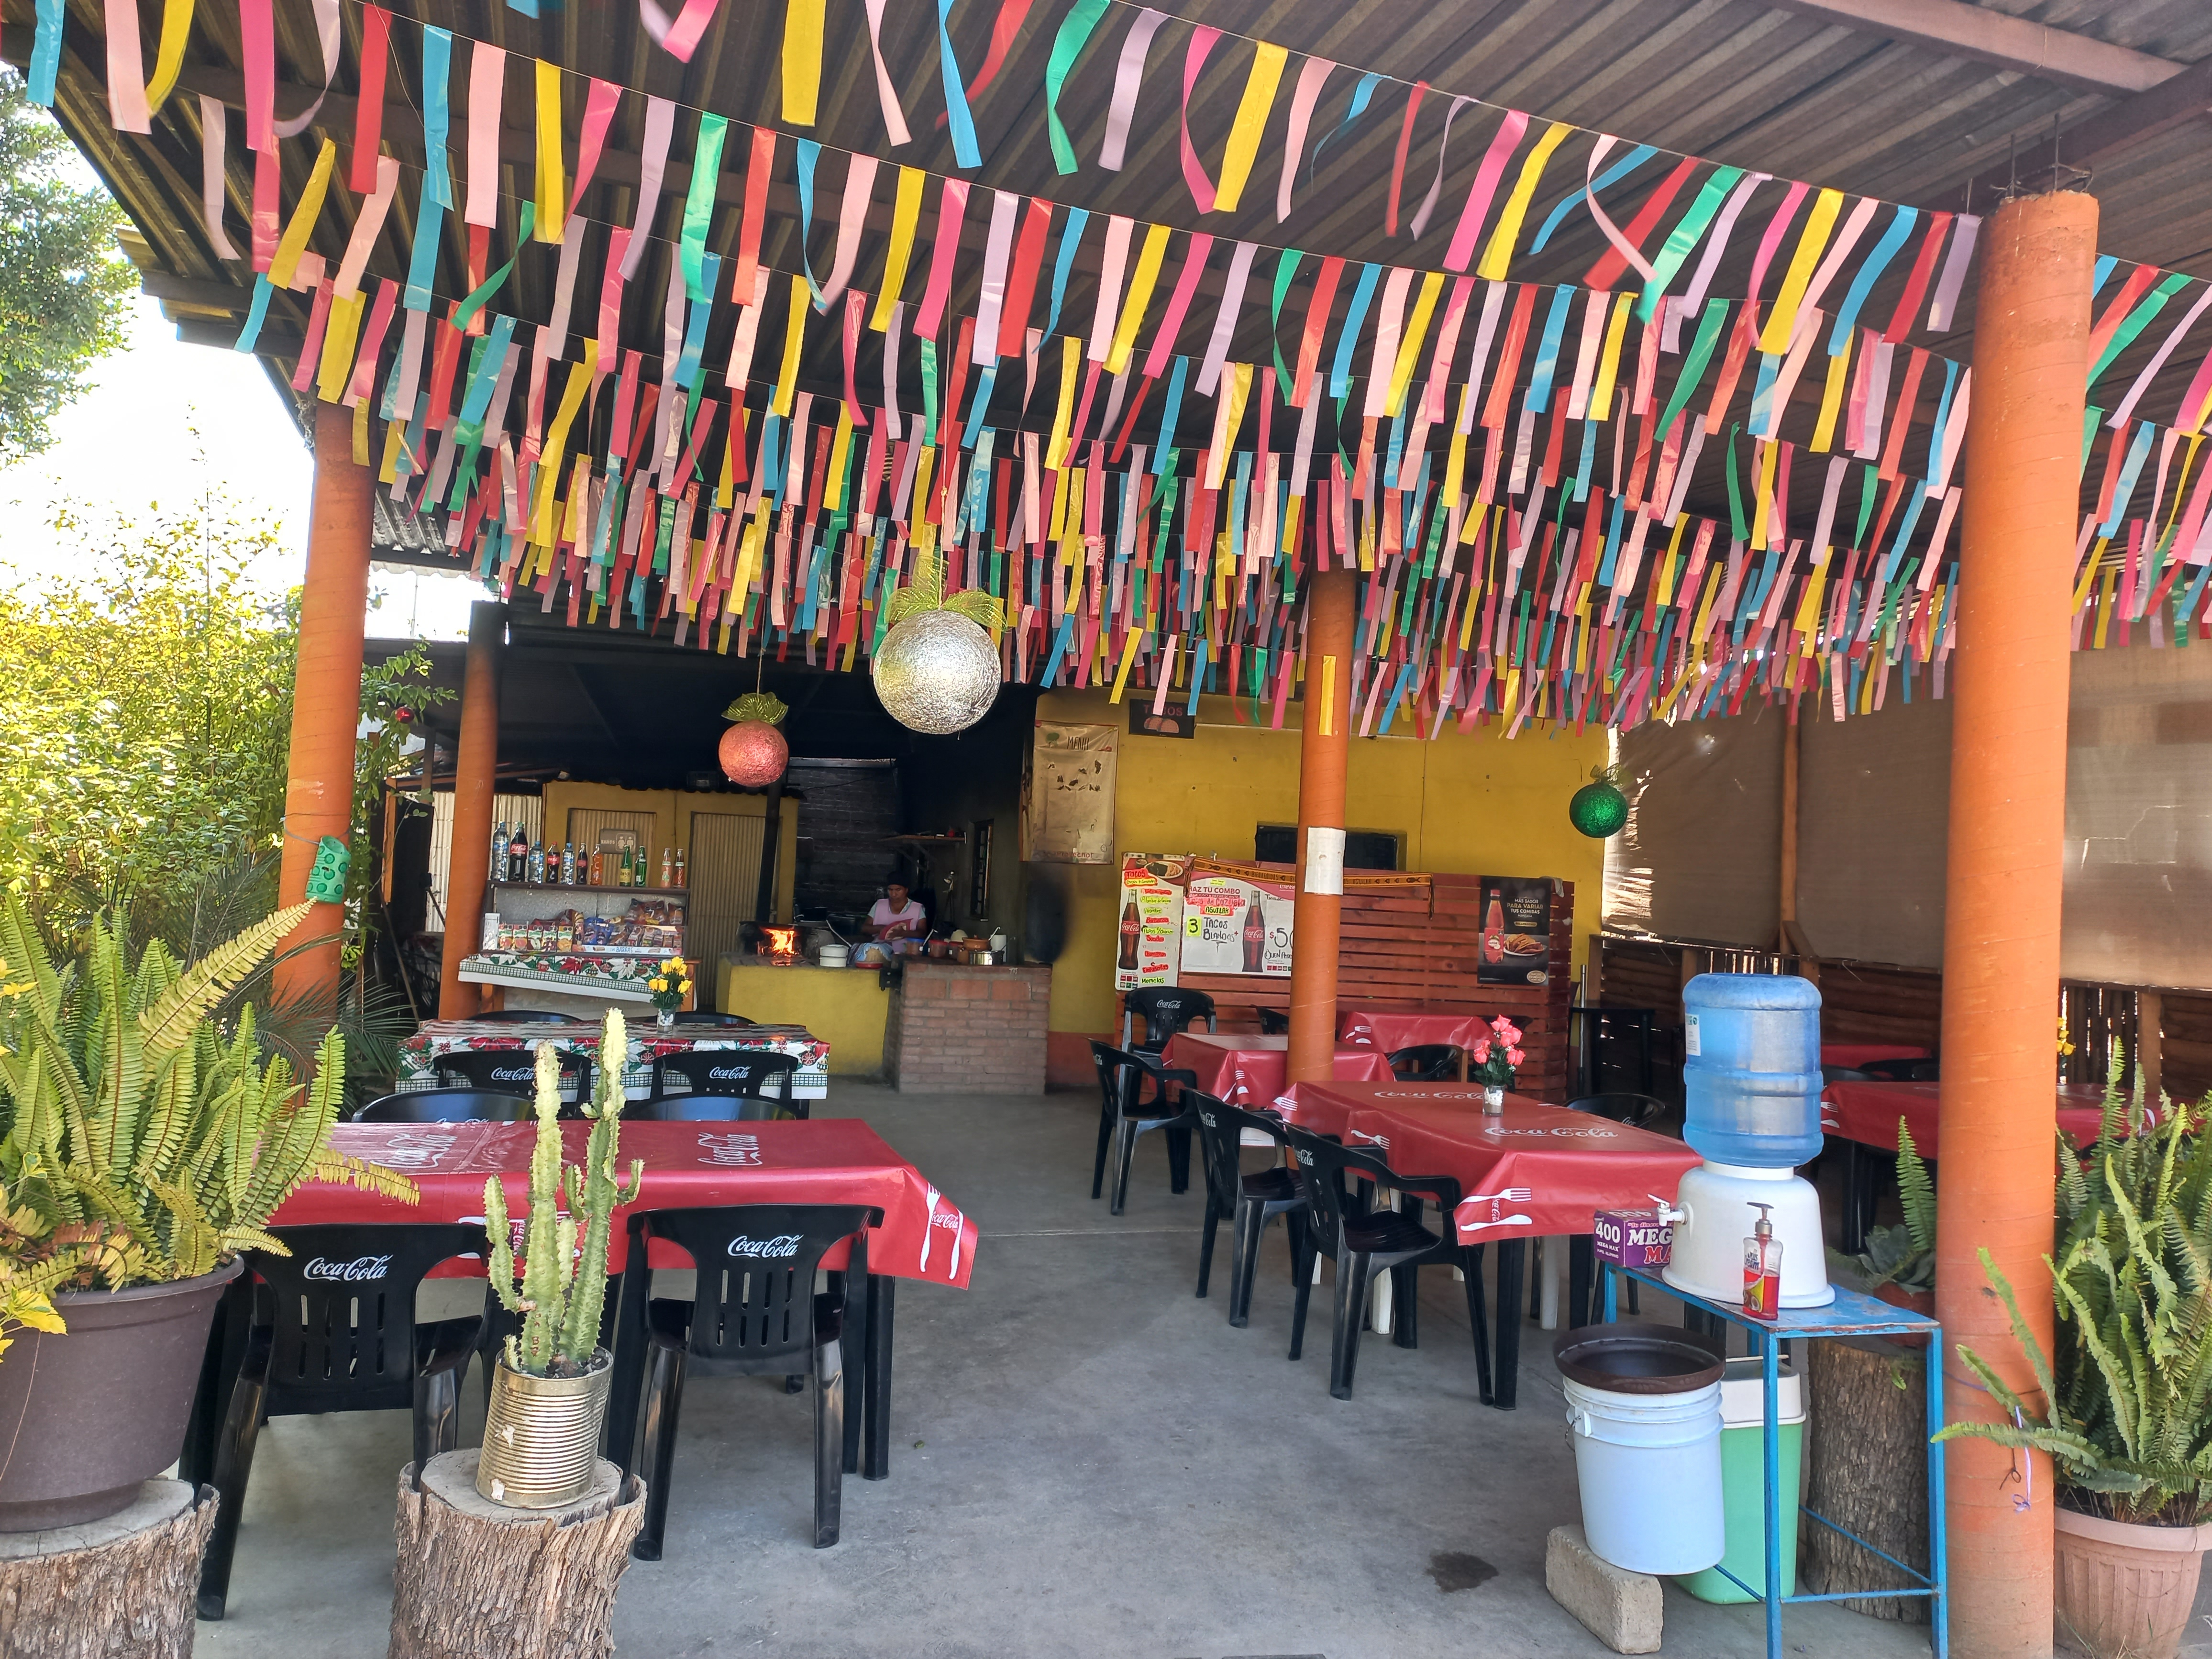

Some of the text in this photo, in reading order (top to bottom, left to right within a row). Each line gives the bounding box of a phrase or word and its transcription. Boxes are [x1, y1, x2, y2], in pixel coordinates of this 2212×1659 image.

[1144, 704, 1183, 717] TOS
[1189, 917, 1228, 933] 3 TACOS
[1157, 999, 1182, 1009] Coca-Cola
[491, 1067, 535, 1081] Coca-Cola
[709, 1066, 752, 1079] Coca-Cola
[1484, 1127, 1618, 1138] Coca-Cola
[1595, 1221, 1621, 1243] 400
[1627, 1228, 1673, 1246] MEG
[728, 1234, 805, 1258] Coca-Cola
[1597, 1241, 1609, 1249] MEGA
[1644, 1245, 1672, 1264] MA
[303, 1254, 394, 1282] Coca-Cola
